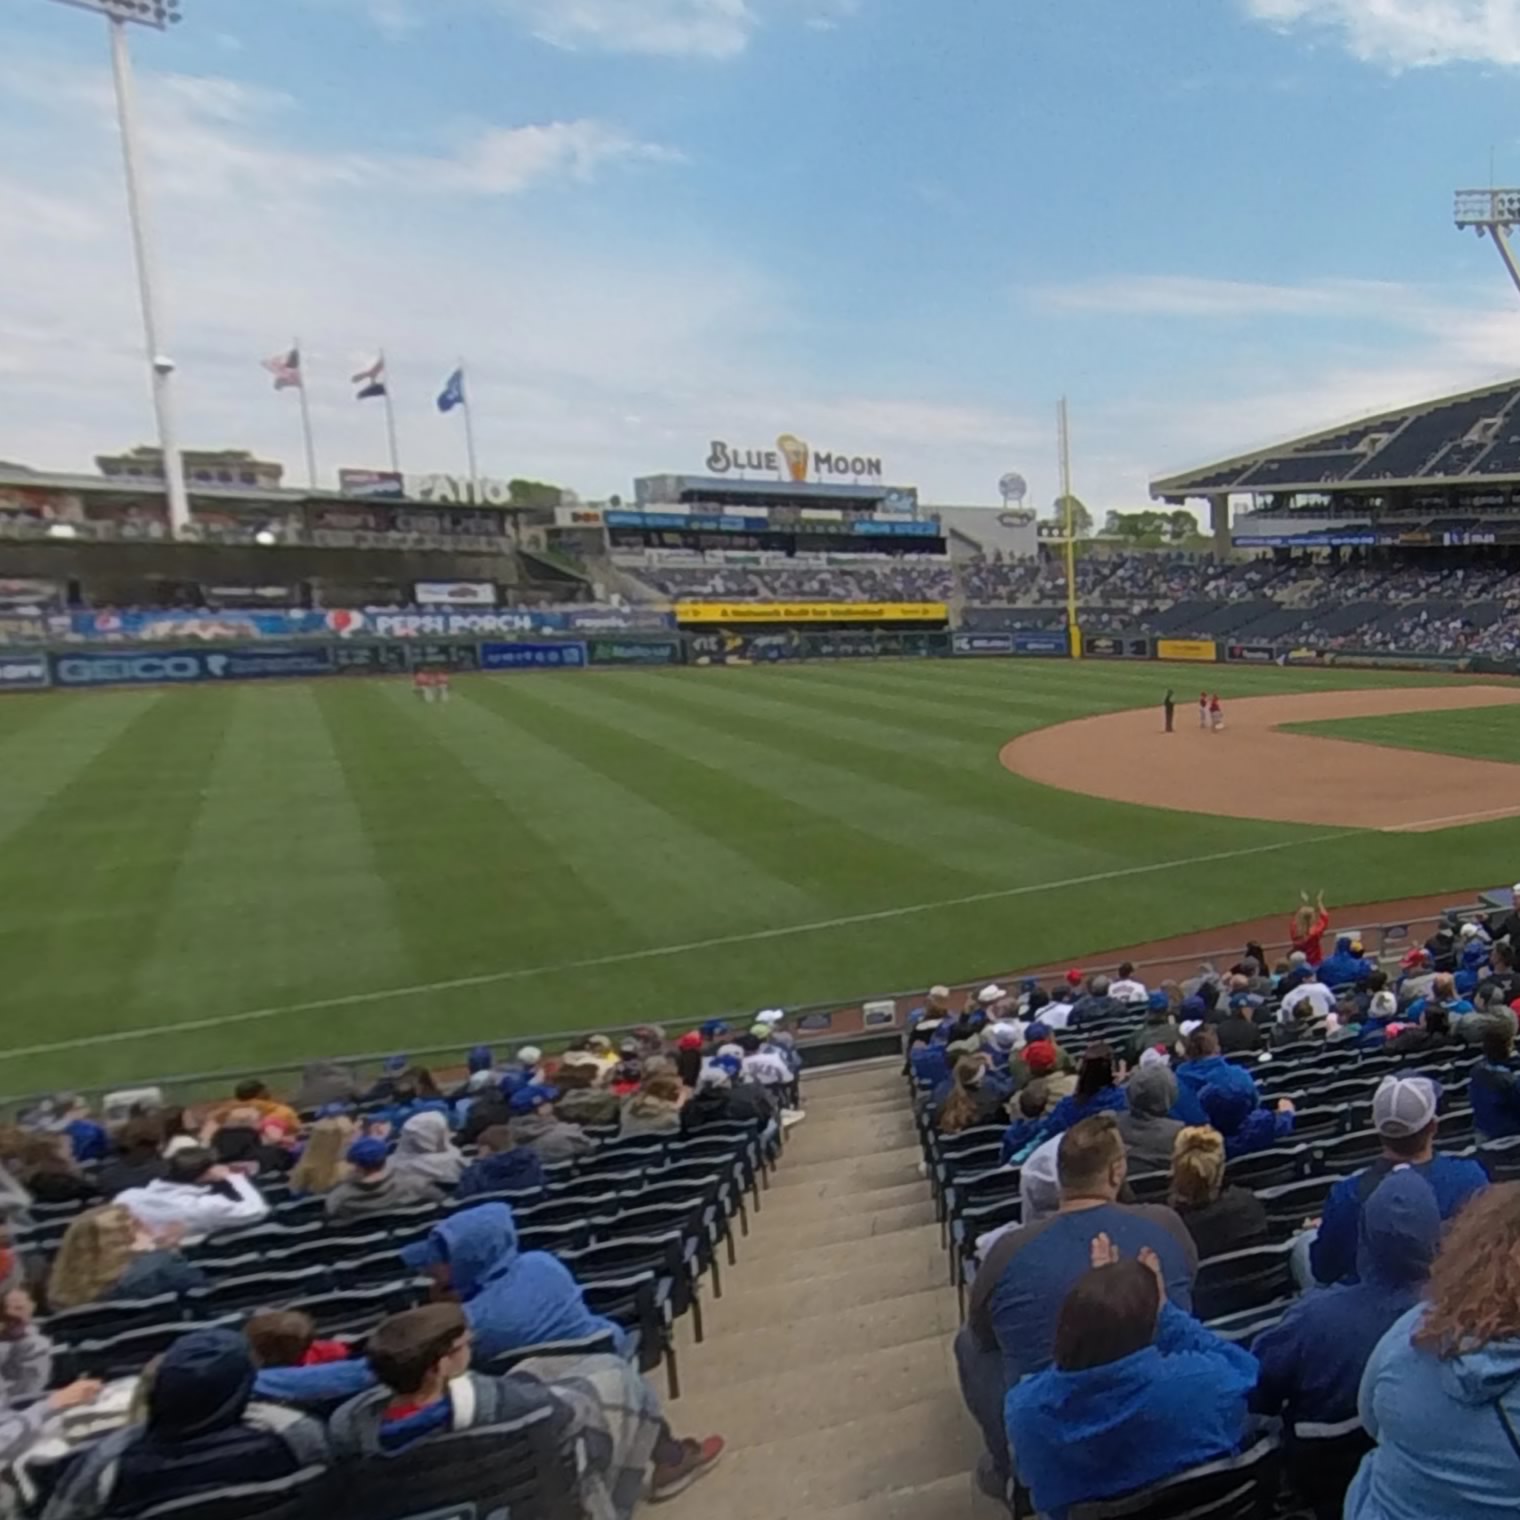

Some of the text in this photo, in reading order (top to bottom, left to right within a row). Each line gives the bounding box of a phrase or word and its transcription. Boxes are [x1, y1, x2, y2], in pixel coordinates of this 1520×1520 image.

[706, 440, 882, 476] BLUE MOON
[405, 474, 512, 506] PATIO
[376, 614, 533, 636] PEPSI PORCH
[720, 608, 729, 618] A
[784, 608, 809, 616] Built
[57, 656, 200, 682] GEICO
